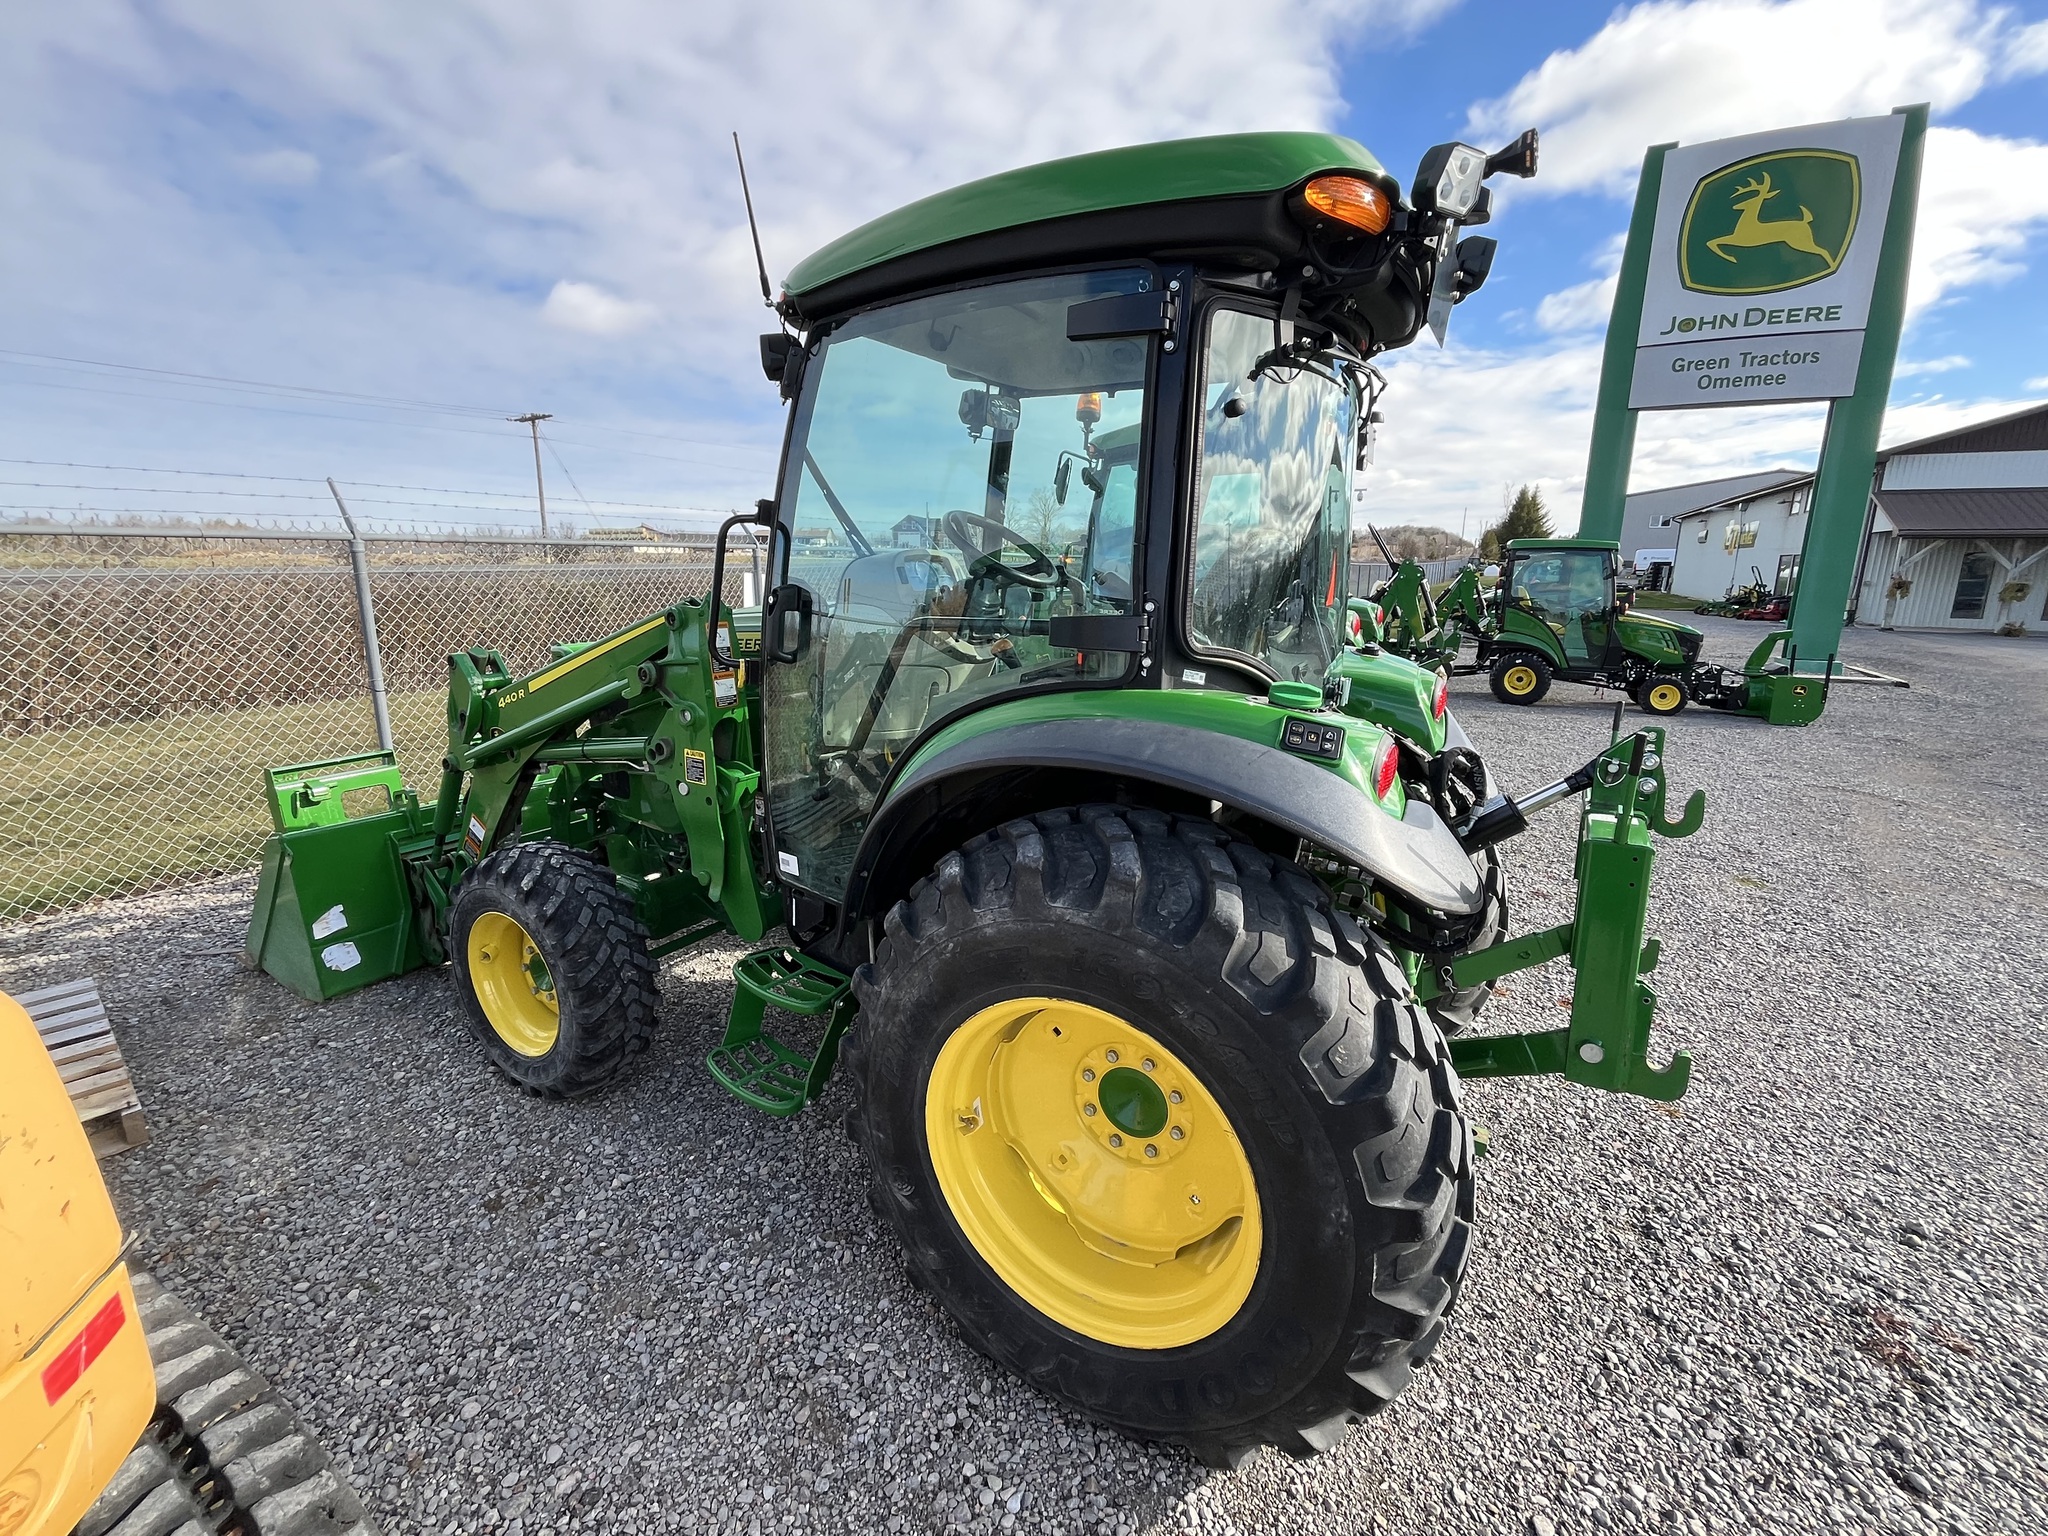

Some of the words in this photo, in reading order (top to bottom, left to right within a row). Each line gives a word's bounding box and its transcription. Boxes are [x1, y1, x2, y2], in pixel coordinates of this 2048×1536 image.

[1660, 312, 1739, 336] JOHN
[1743, 305, 1843, 327] DEERE
[1671, 356, 1730, 373] Green
[1739, 350, 1820, 368] Tractors
[1697, 373, 1787, 390] Omemee
[739, 638, 761, 651] EER
